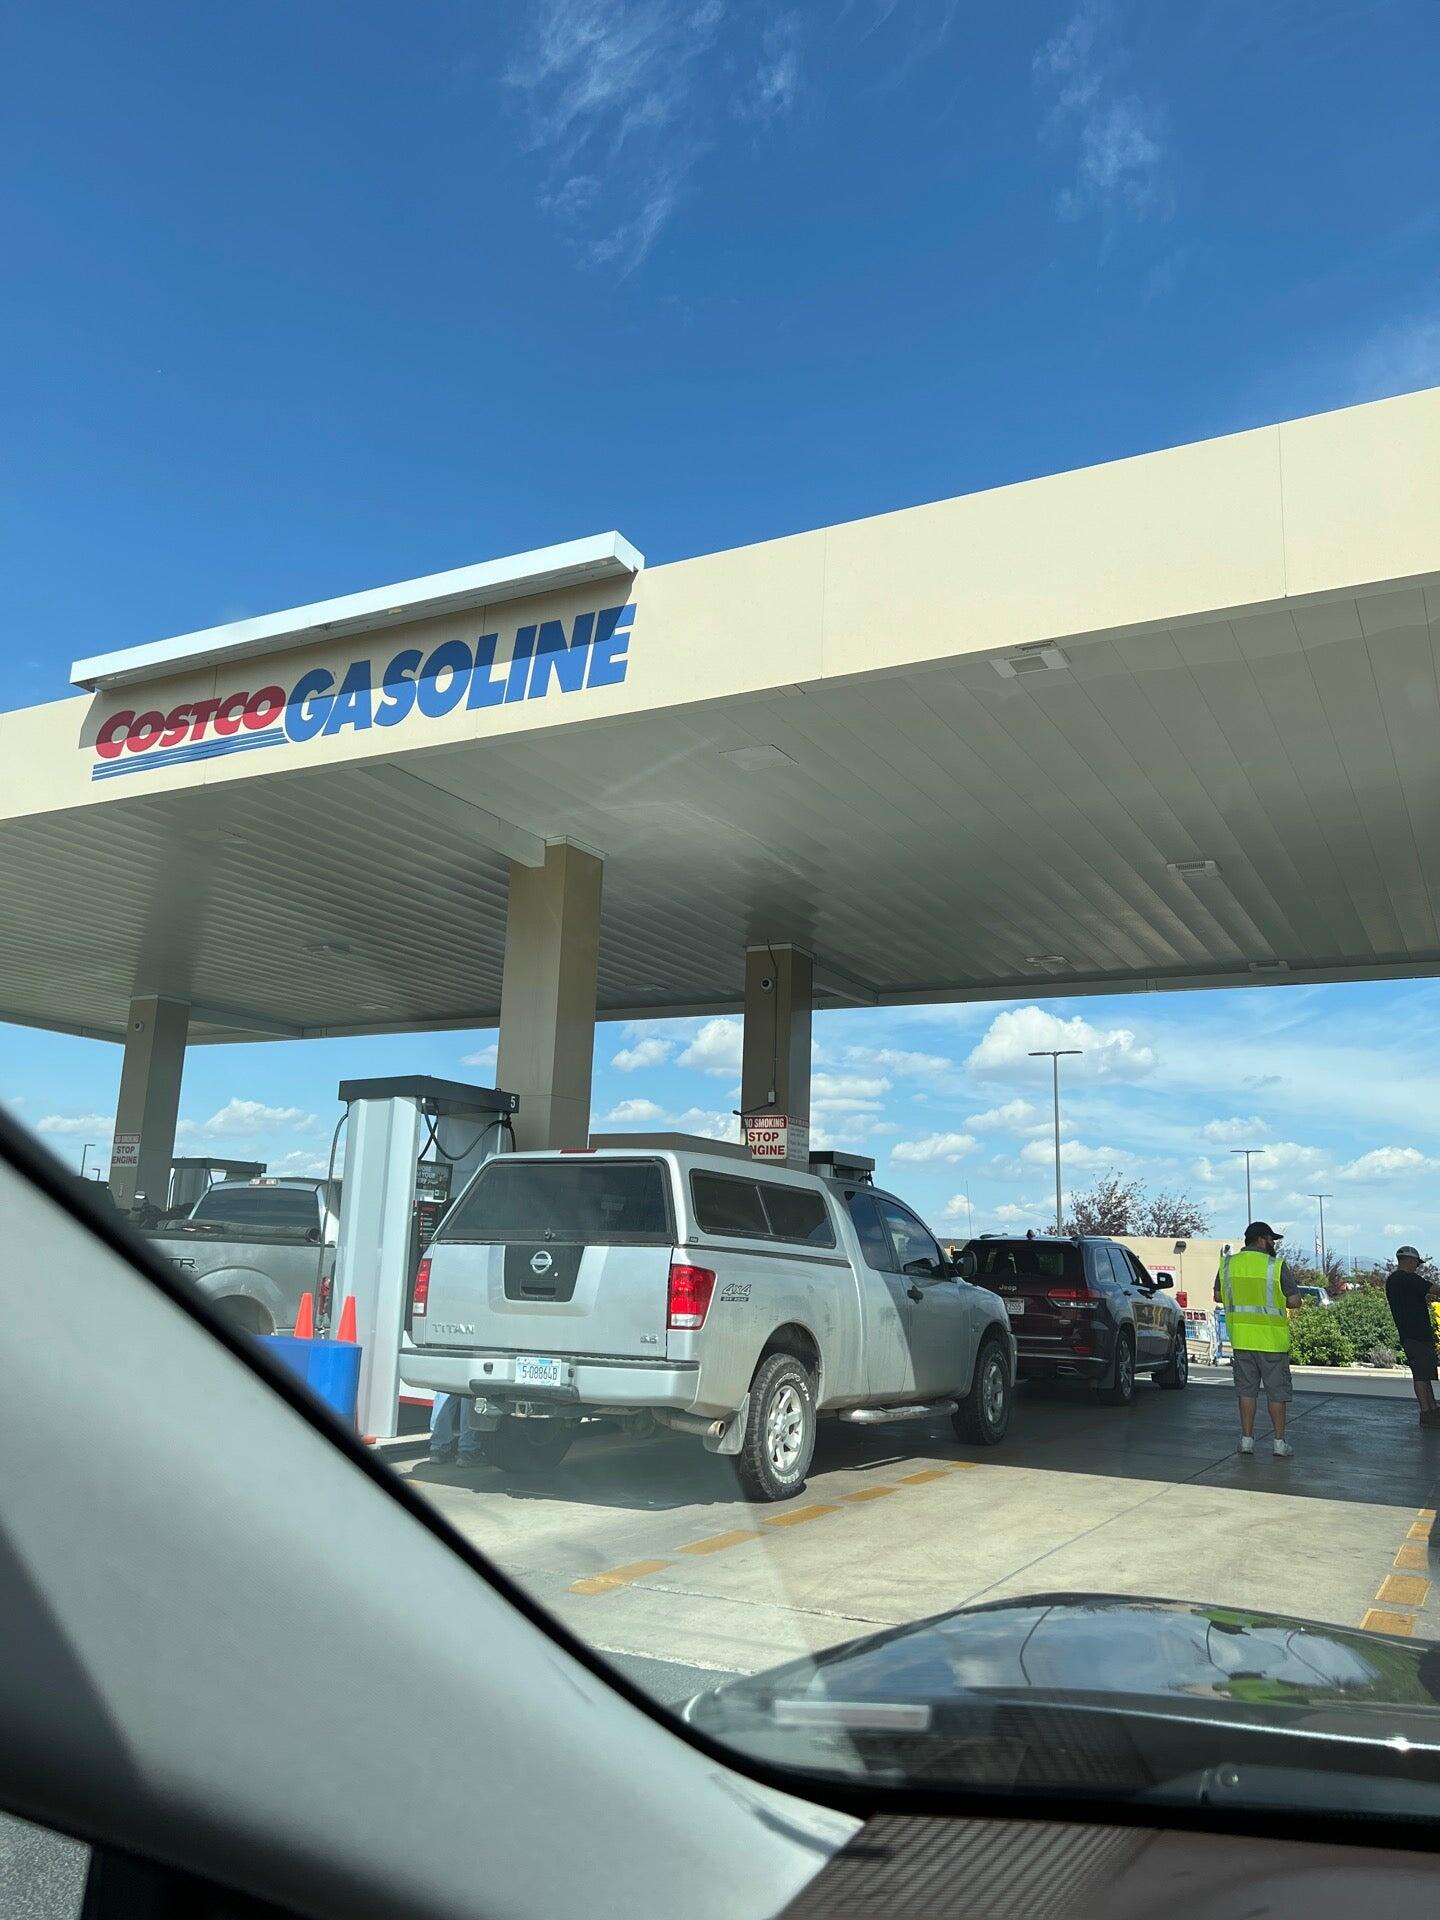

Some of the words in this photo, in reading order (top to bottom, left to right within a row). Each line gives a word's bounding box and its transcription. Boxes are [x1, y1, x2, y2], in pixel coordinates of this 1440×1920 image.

[95, 685, 287, 759] COSTCO
[284, 602, 638, 743] GASOLINE
[510, 1096, 516, 1109] 5
[754, 1118, 784, 1128] SMOKING
[749, 1132, 779, 1142] STOP
[116, 1145, 135, 1154] STOP
[751, 1145, 785, 1155] NGINE
[111, 1155, 137, 1165] ENGINE
[999, 1284, 1017, 1292] Jeep
[431, 1323, 475, 1336] TITAN
